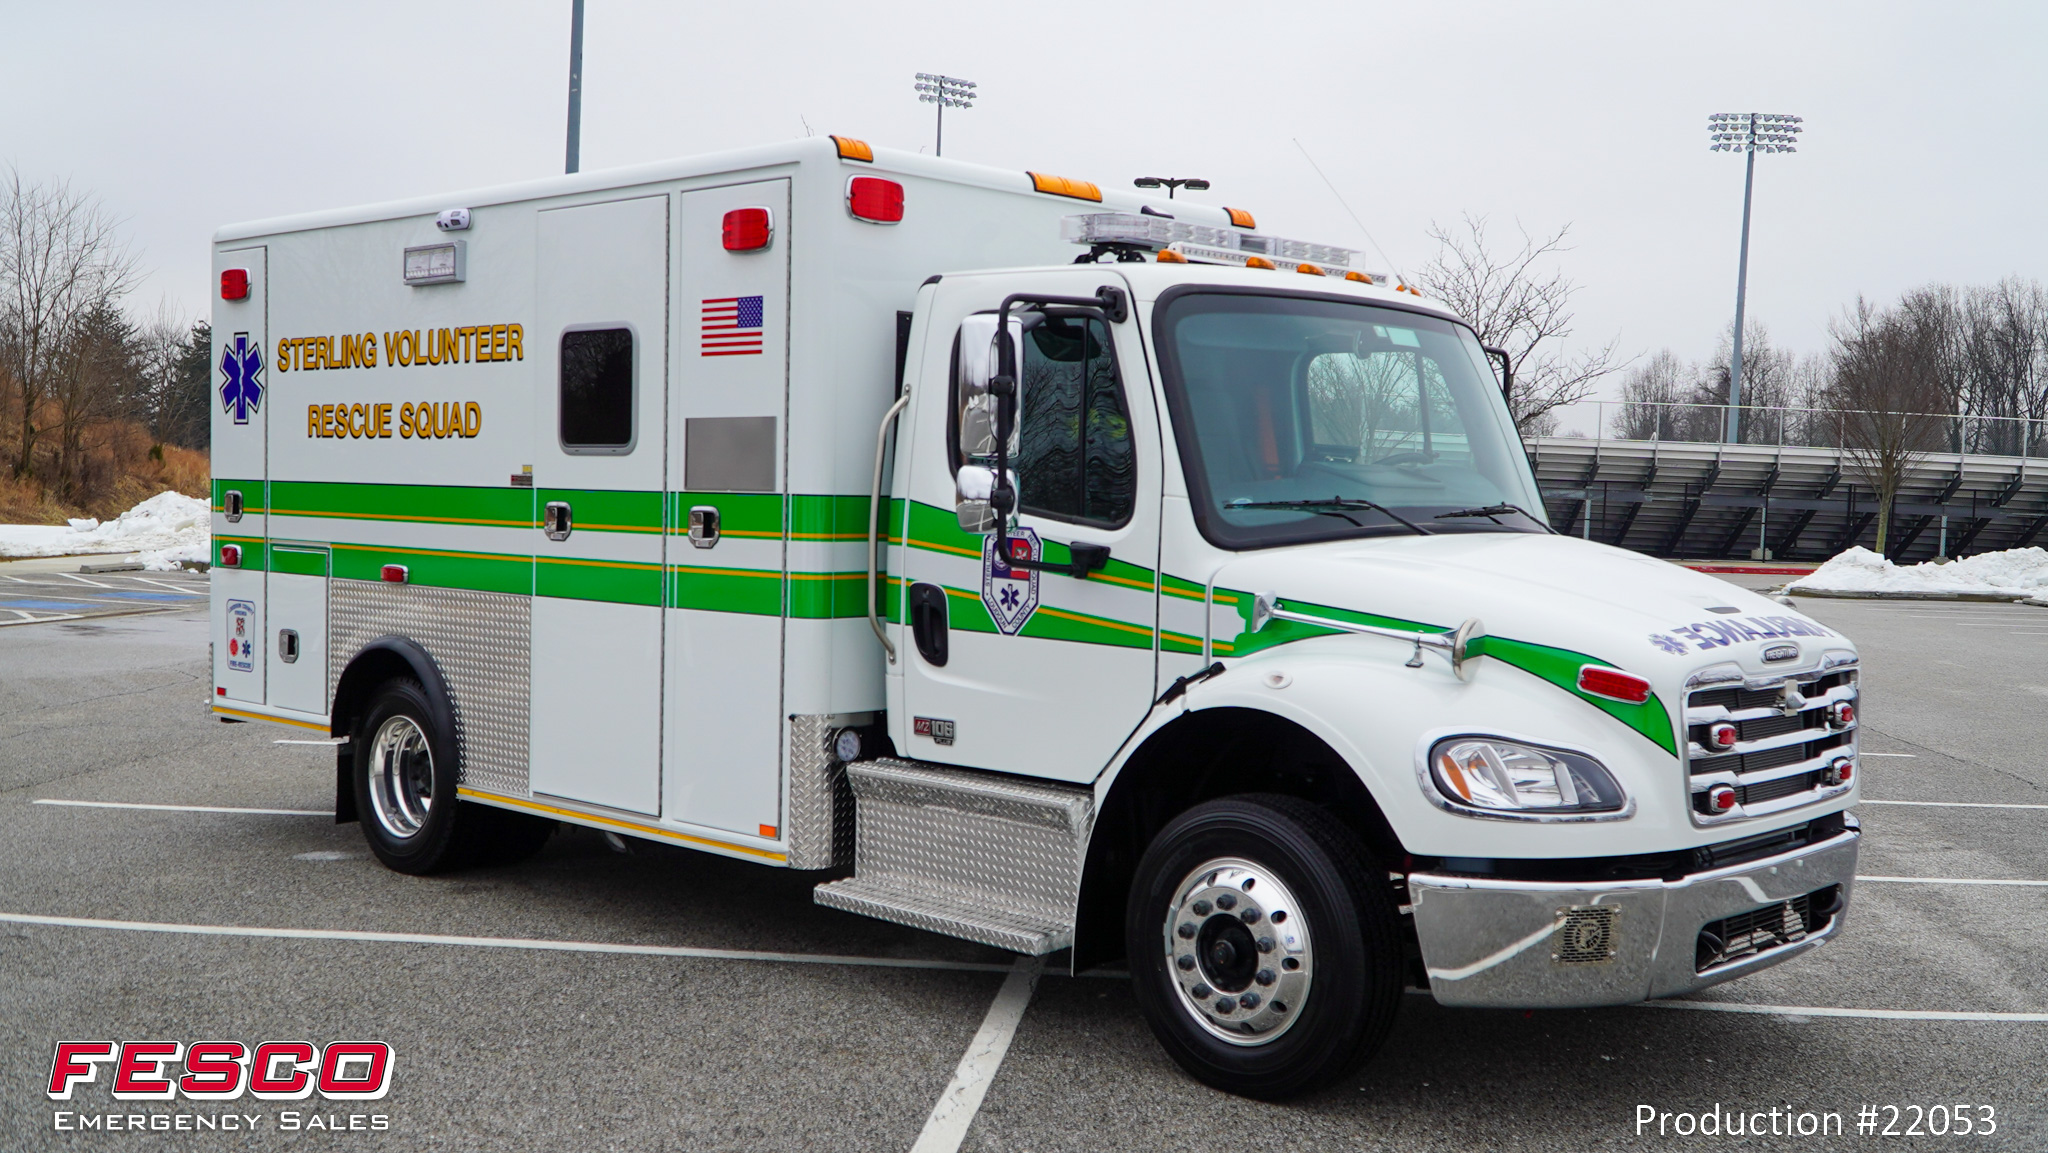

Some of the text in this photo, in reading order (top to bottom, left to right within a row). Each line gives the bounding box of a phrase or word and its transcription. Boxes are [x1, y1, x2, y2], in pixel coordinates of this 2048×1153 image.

[277, 323, 524, 372] STERLING VOLUNTEER
[308, 402, 482, 440] RESCUE SQUAD
[1027, 534, 1038, 563] RESCU
[987, 597, 1031, 629] LOUDOUN COUNTY
[916, 720, 953, 737] M2 106
